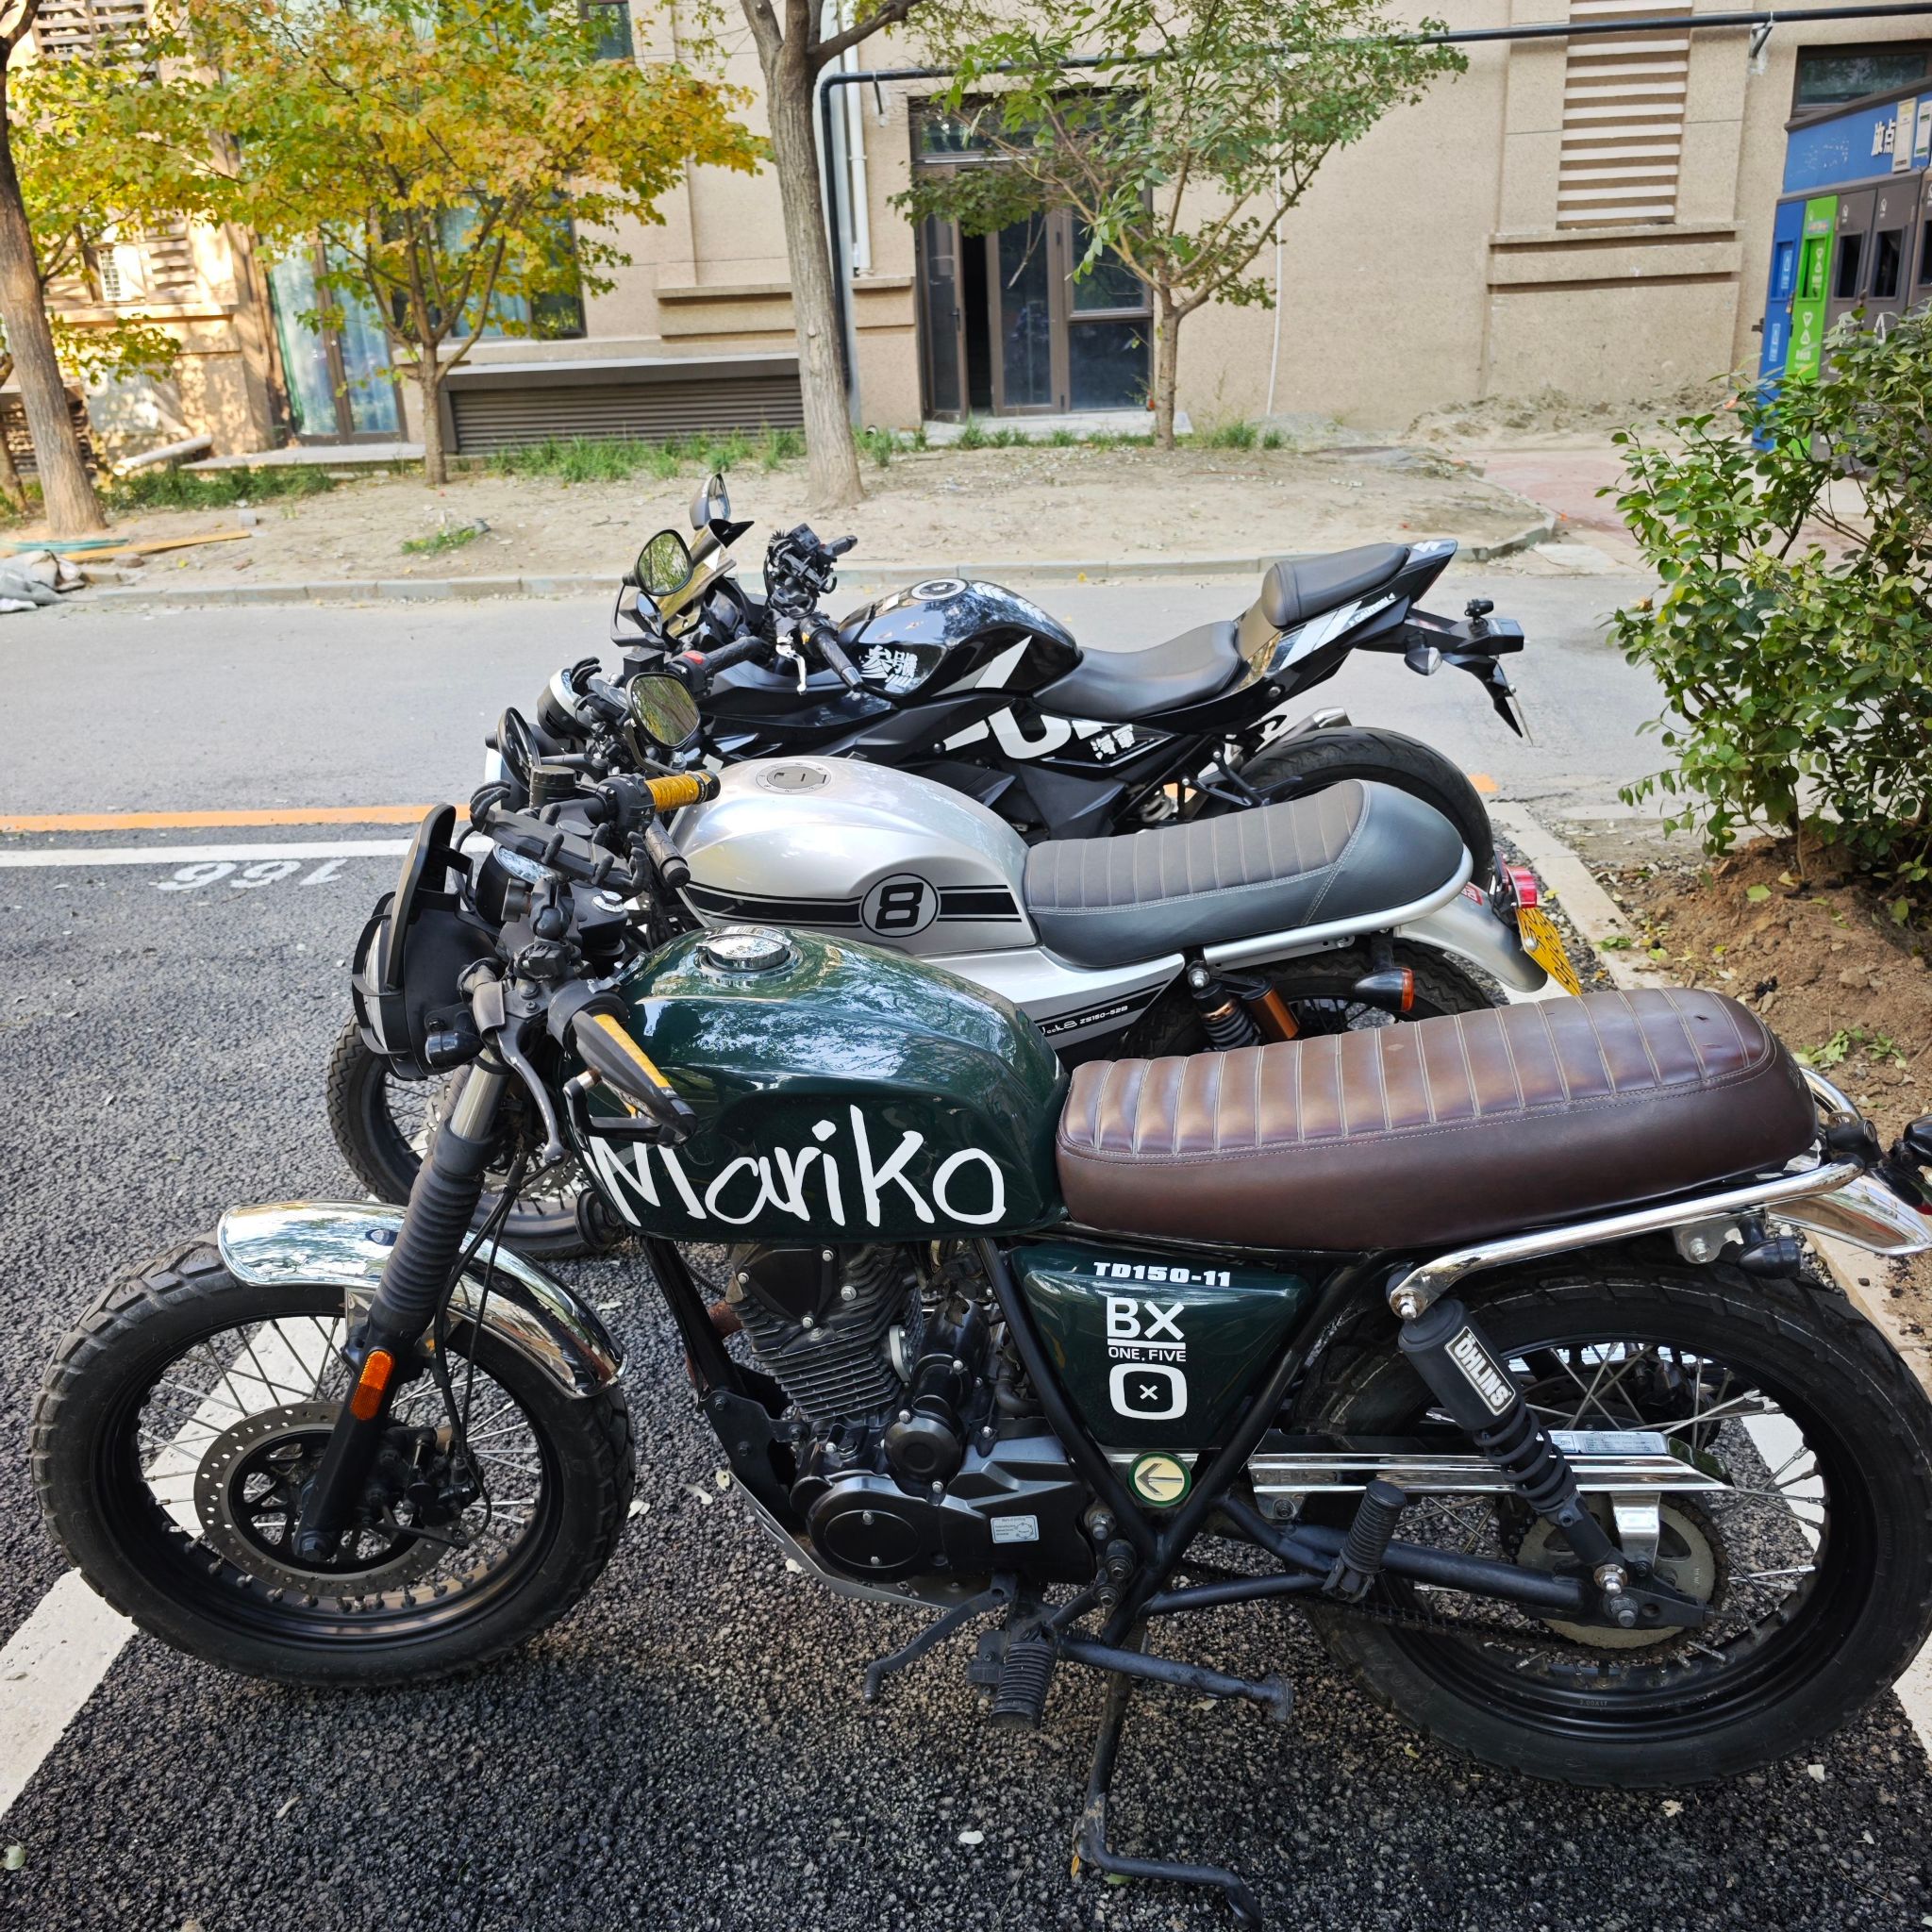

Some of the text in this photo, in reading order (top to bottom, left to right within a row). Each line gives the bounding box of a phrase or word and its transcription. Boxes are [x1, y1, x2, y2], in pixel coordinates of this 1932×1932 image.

[874, 881, 924, 930] 8
[583, 1104, 1007, 1227] Mariko
[1093, 1261, 1231, 1288] TD150-11
[1107, 1296, 1185, 1341] BX
